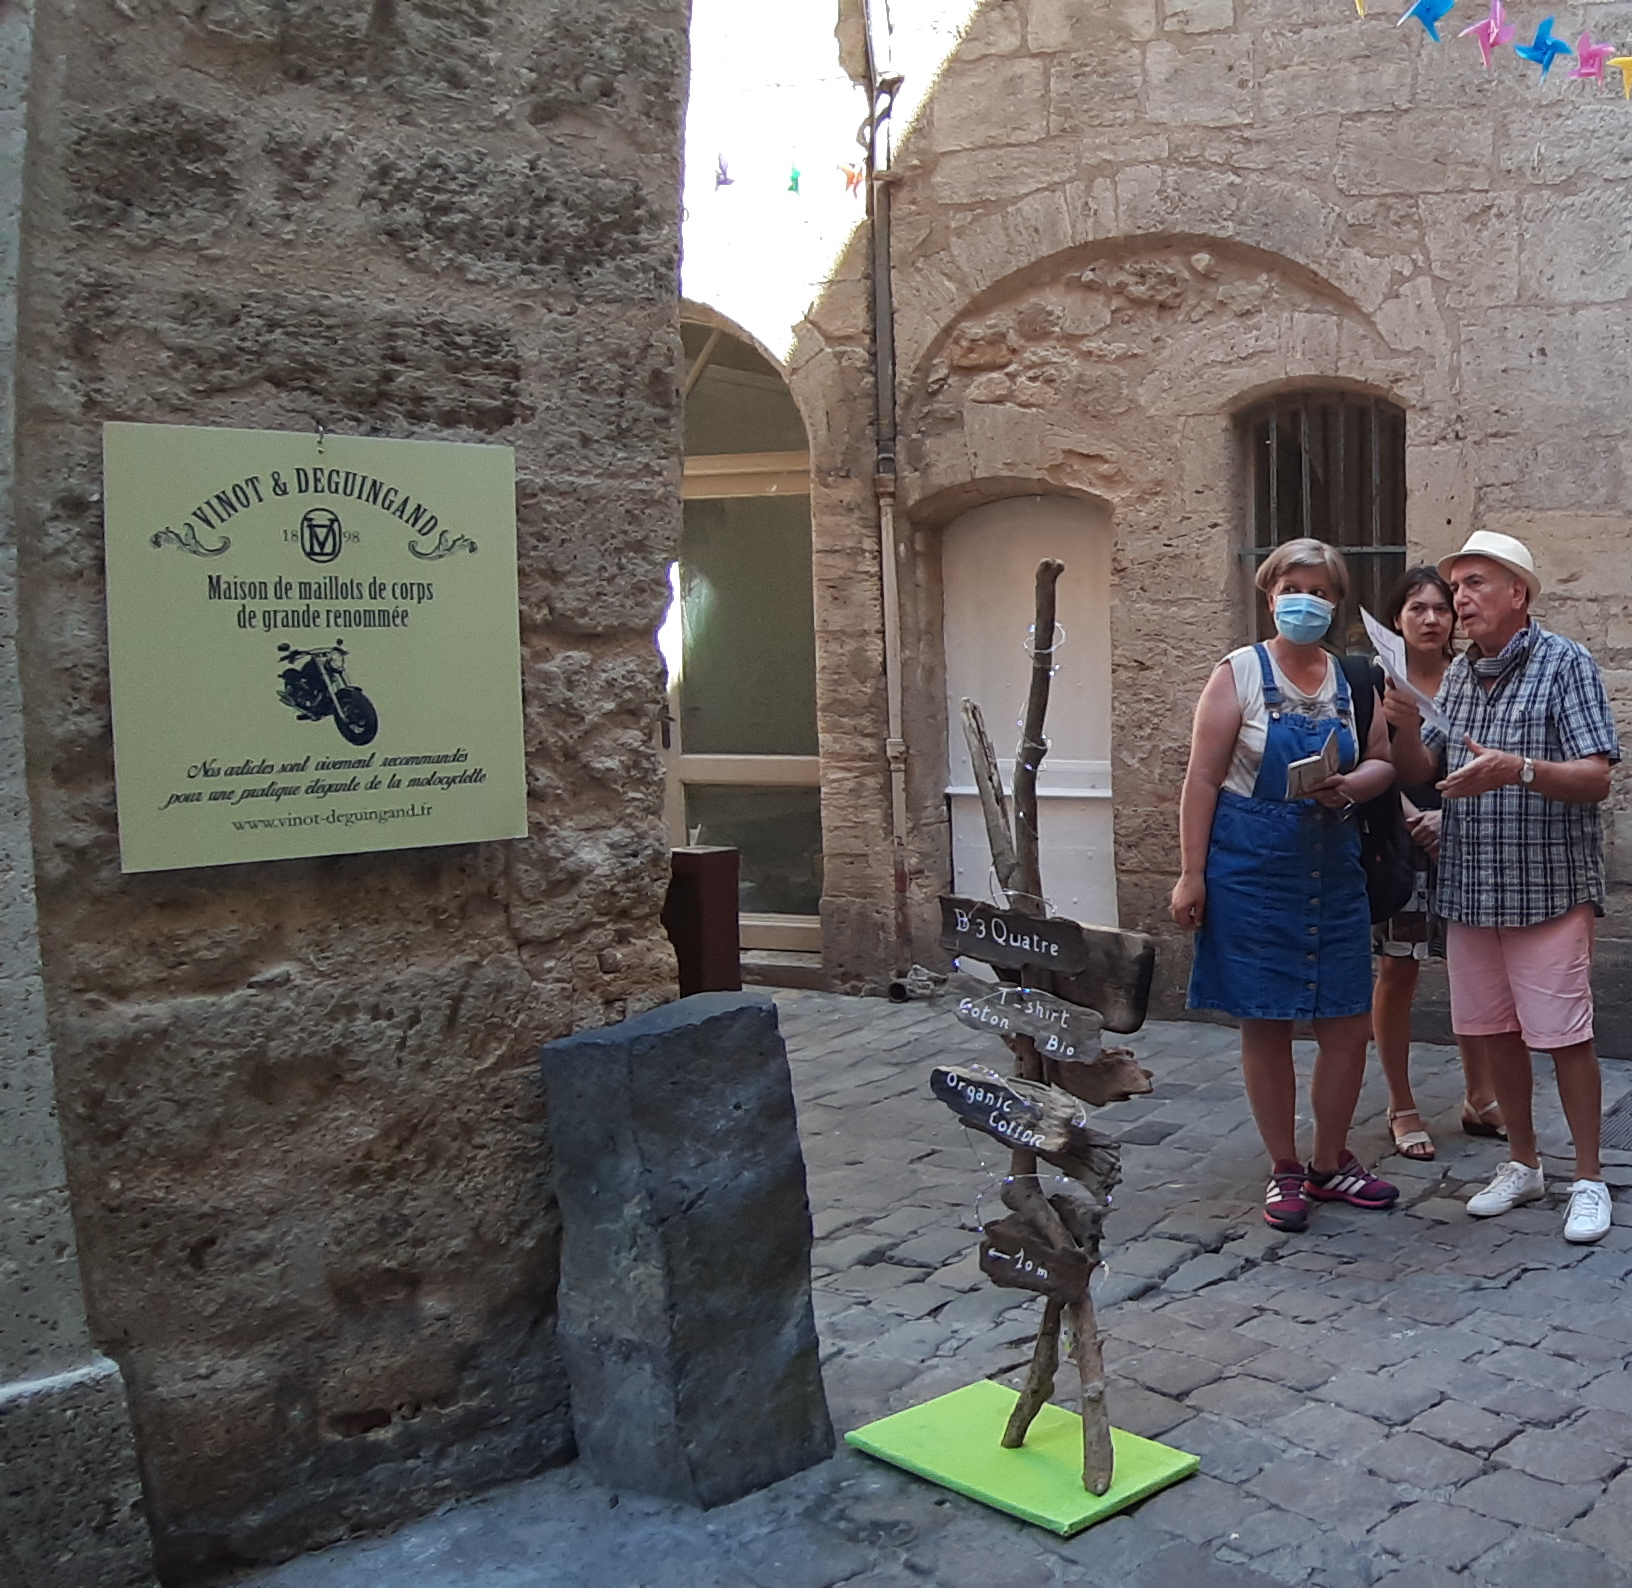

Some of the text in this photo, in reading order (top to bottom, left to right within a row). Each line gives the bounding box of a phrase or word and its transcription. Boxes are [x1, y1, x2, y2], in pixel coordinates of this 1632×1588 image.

[191, 466, 439, 537] VINOT & DEGUINGAND
[282, 530, 298, 543] 18
[342, 531, 361, 543] 98
[207, 574, 434, 604] Maison de maillots de corps
[237, 603, 409, 632] de grande renommée
[187, 747, 468, 779] Nos articles sont vivement recommandés
[158, 767, 487, 811] pour une pratique élégante de la motocyclette
[231, 801, 433, 831] www.vinot-deguingand.fr
[1046, 1034, 1075, 1056] Bio
[946, 1072, 1013, 1112] Organic
[988, 1110, 1046, 1148] Cotton
